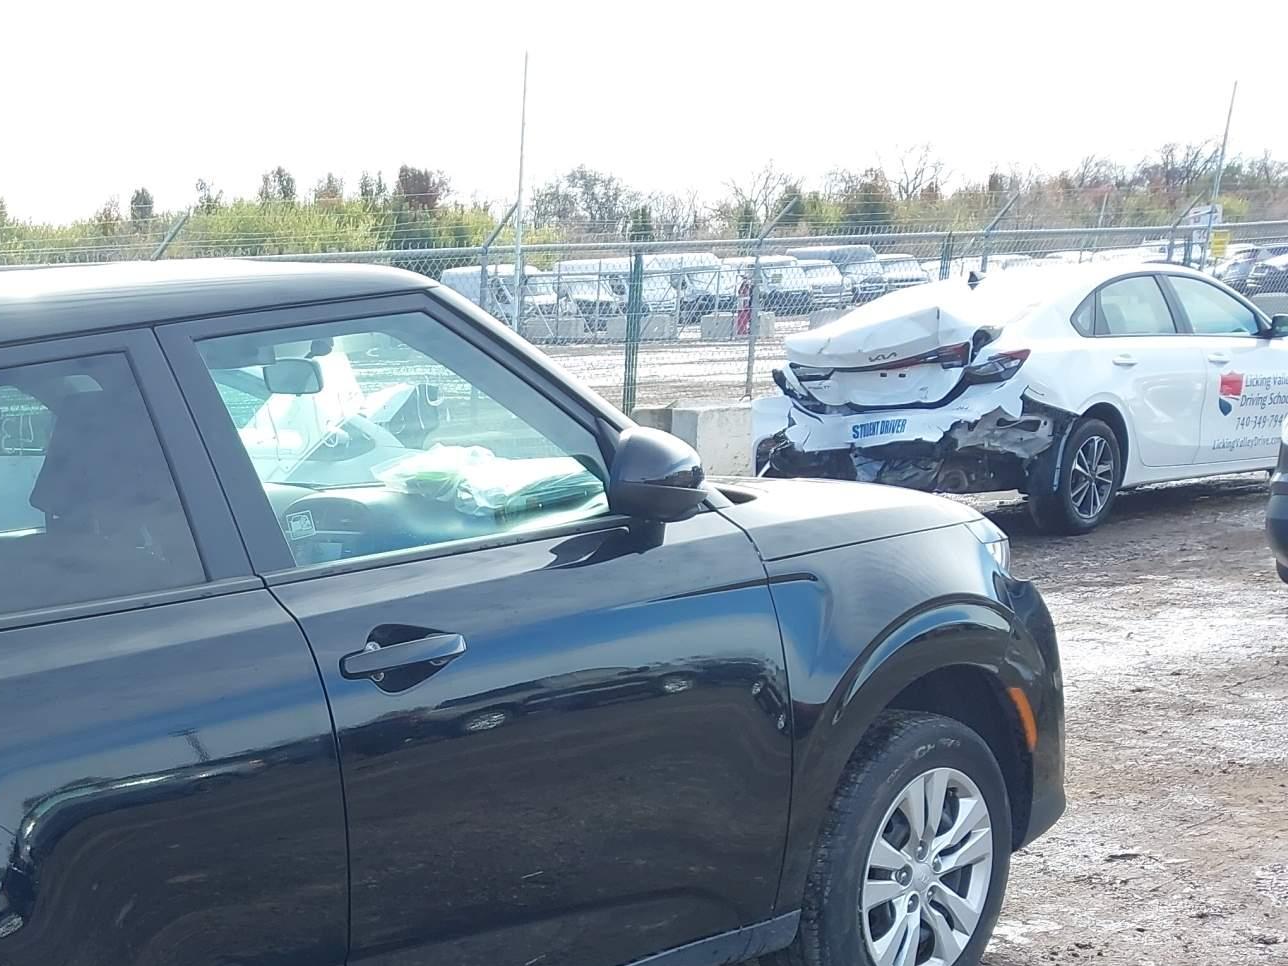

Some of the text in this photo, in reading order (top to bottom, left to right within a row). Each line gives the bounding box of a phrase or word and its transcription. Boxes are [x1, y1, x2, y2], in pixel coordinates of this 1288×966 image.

[1240, 393, 1268, 410] Driving
[879, 418, 908, 435] DRIVER
[1235, 413, 1288, 431] 740-349-794
